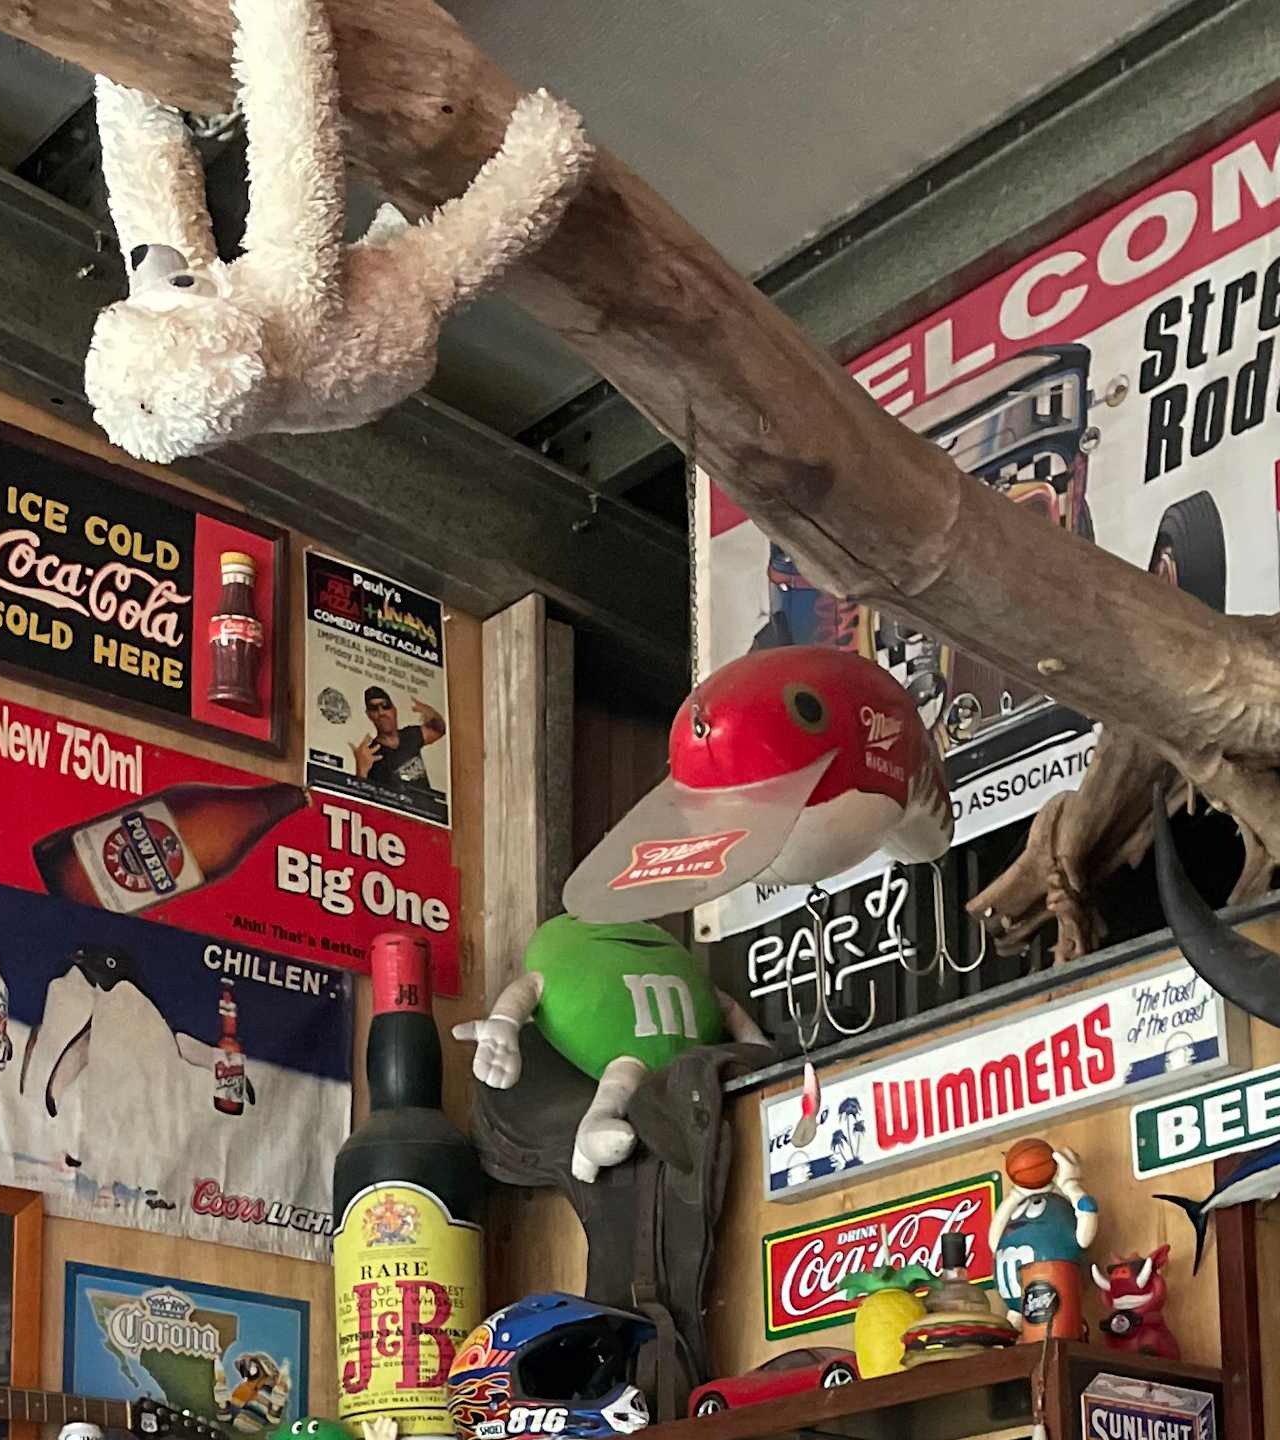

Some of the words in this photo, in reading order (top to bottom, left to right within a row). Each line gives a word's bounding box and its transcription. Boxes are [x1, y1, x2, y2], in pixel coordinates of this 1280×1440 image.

[7, 486, 68, 533] ICE
[85, 515, 180, 572] COLD
[94, 634, 184, 689] HERE
[314, 609, 360, 632] COMEDY
[363, 626, 438, 662] SPECTACULAR
[56, 721, 143, 796] 750ml
[322, 805, 406, 867] The
[276, 847, 353, 915] Big
[362, 868, 450, 932] One
[629, 864, 671, 880] HIGH
[675, 861, 713, 877] LIFE
[623, 973, 698, 1038] m
[872, 1004, 1114, 1148] WIMMERS
[838, 1223, 877, 1244] DRINK
[361, 1261, 429, 1280] RARE
[110, 1307, 221, 1355] Corona
[508, 1407, 568, 1434] 816
